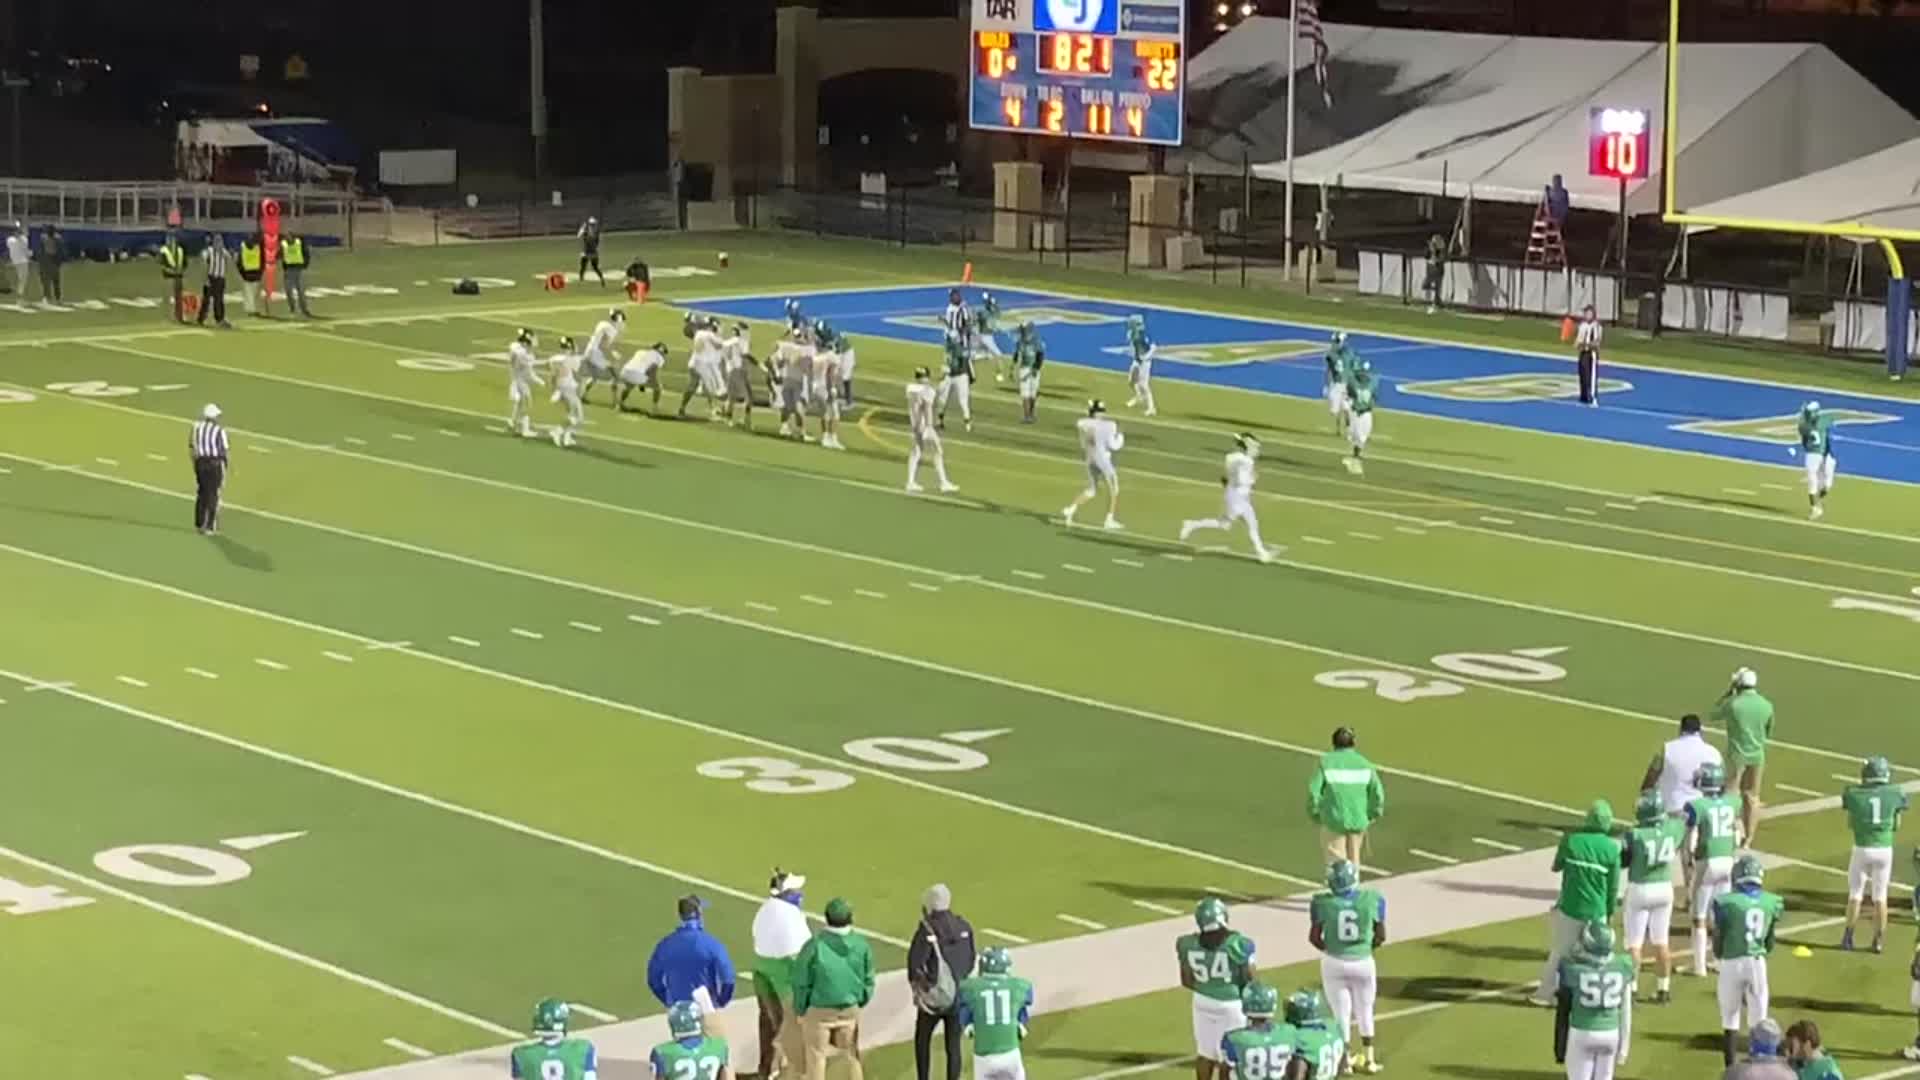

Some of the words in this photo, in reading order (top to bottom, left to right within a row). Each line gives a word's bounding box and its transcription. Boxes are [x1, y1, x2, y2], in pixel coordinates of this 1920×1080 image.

[1147, 58, 1177, 91] 22
[1004, 97, 1021, 127] 4
[1047, 100, 1064, 132] 2
[1088, 103, 1111, 134] 11
[1127, 106, 1143, 137] 4
[1607, 135, 1636, 174] 10
[696, 737, 989, 794] 30
[1708, 805, 1734, 837] 12
[1868, 796, 1881, 824] 1
[1646, 836, 1675, 866] 14
[1337, 910, 1359, 942] 6
[1744, 907, 1765, 941] 9
[1187, 950, 1232, 984] 54
[1579, 971, 1623, 1009] 52
[981, 989, 1011, 1025] 11
